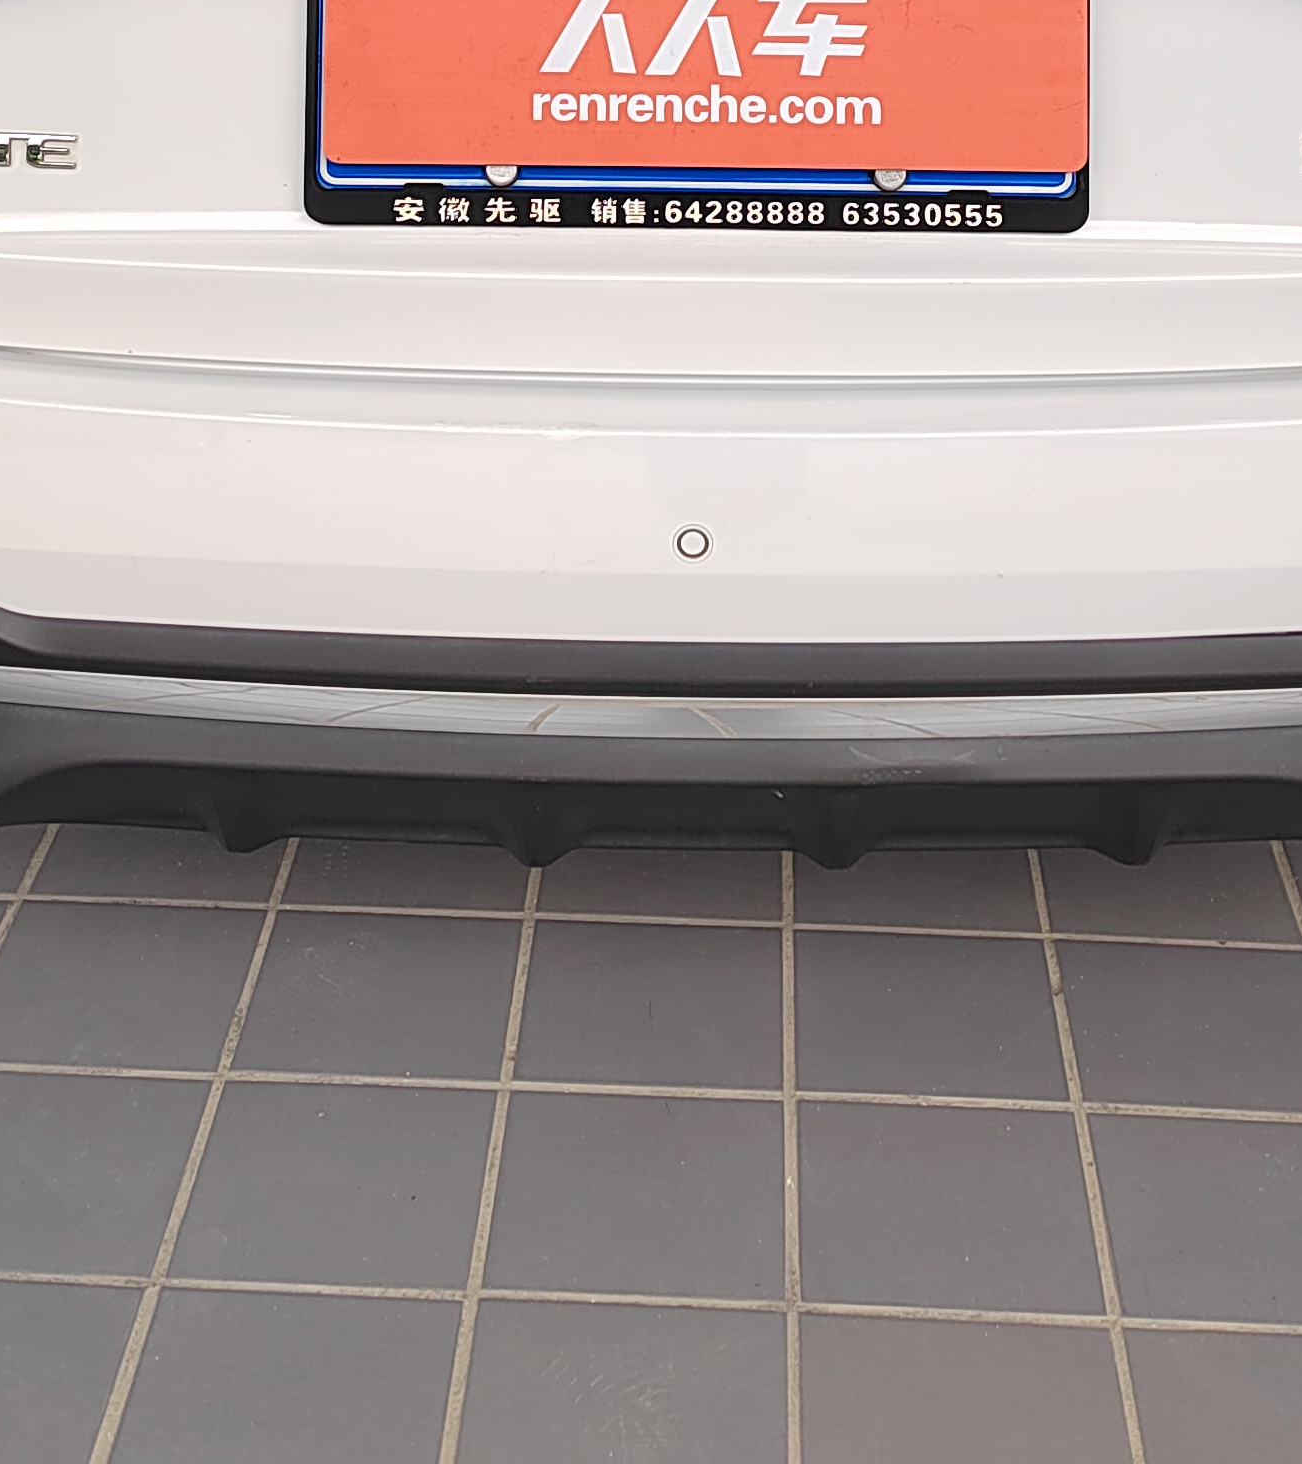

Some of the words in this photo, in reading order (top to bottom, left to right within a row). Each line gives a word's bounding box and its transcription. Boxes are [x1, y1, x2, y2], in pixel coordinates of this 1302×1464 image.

[532, 84, 883, 127] renrenche.com
[392, 196, 563, 224] 安徽先驱
[590, 197, 825, 225] 销售:64288888
[842, 201, 1003, 228] 63530555
